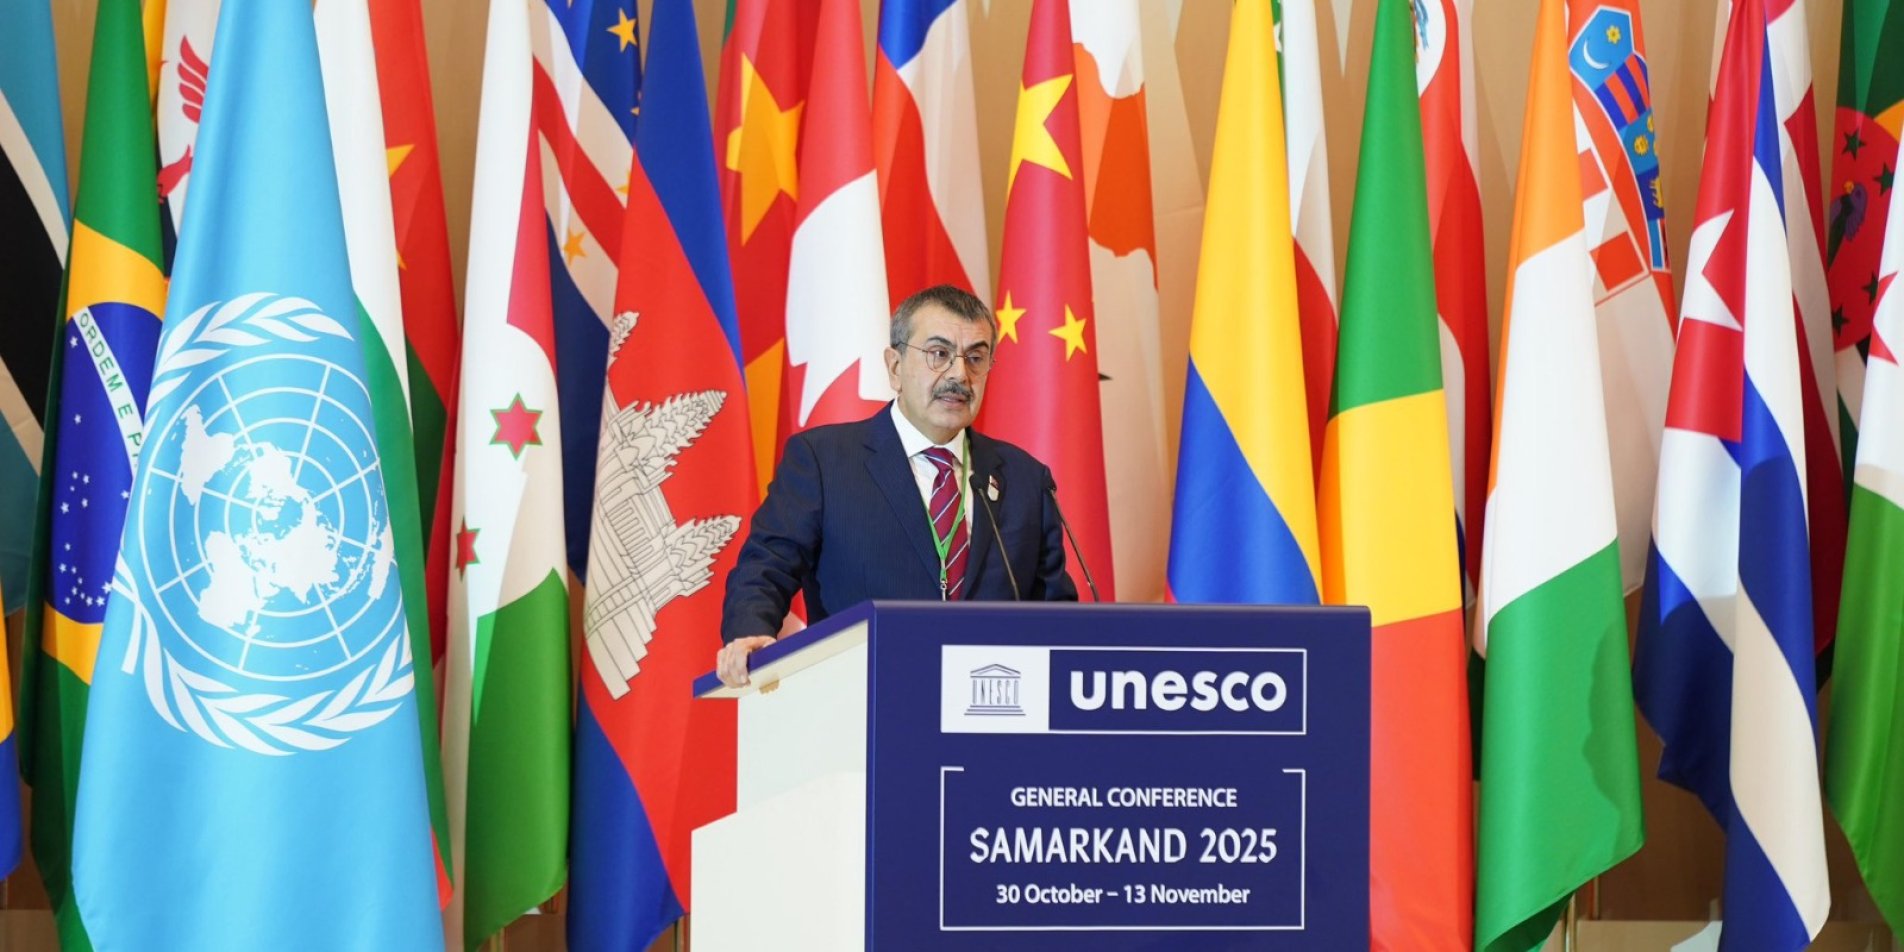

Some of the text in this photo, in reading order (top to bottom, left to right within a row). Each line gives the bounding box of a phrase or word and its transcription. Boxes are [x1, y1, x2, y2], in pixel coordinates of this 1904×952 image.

[79, 312, 123, 393] ORDEM
[118, 404, 133, 419] E
[972, 679, 1019, 705] UNESCO
[1070, 670, 1287, 712] unesco
[1010, 786, 1238, 808] GENERAL CONFERENCE
[970, 827, 1277, 864] SAMARKAND 2025
[996, 884, 1021, 904] 30
[1024, 883, 1104, 904] October
[1123, 884, 1146, 904] 13
[1150, 883, 1251, 904] November
